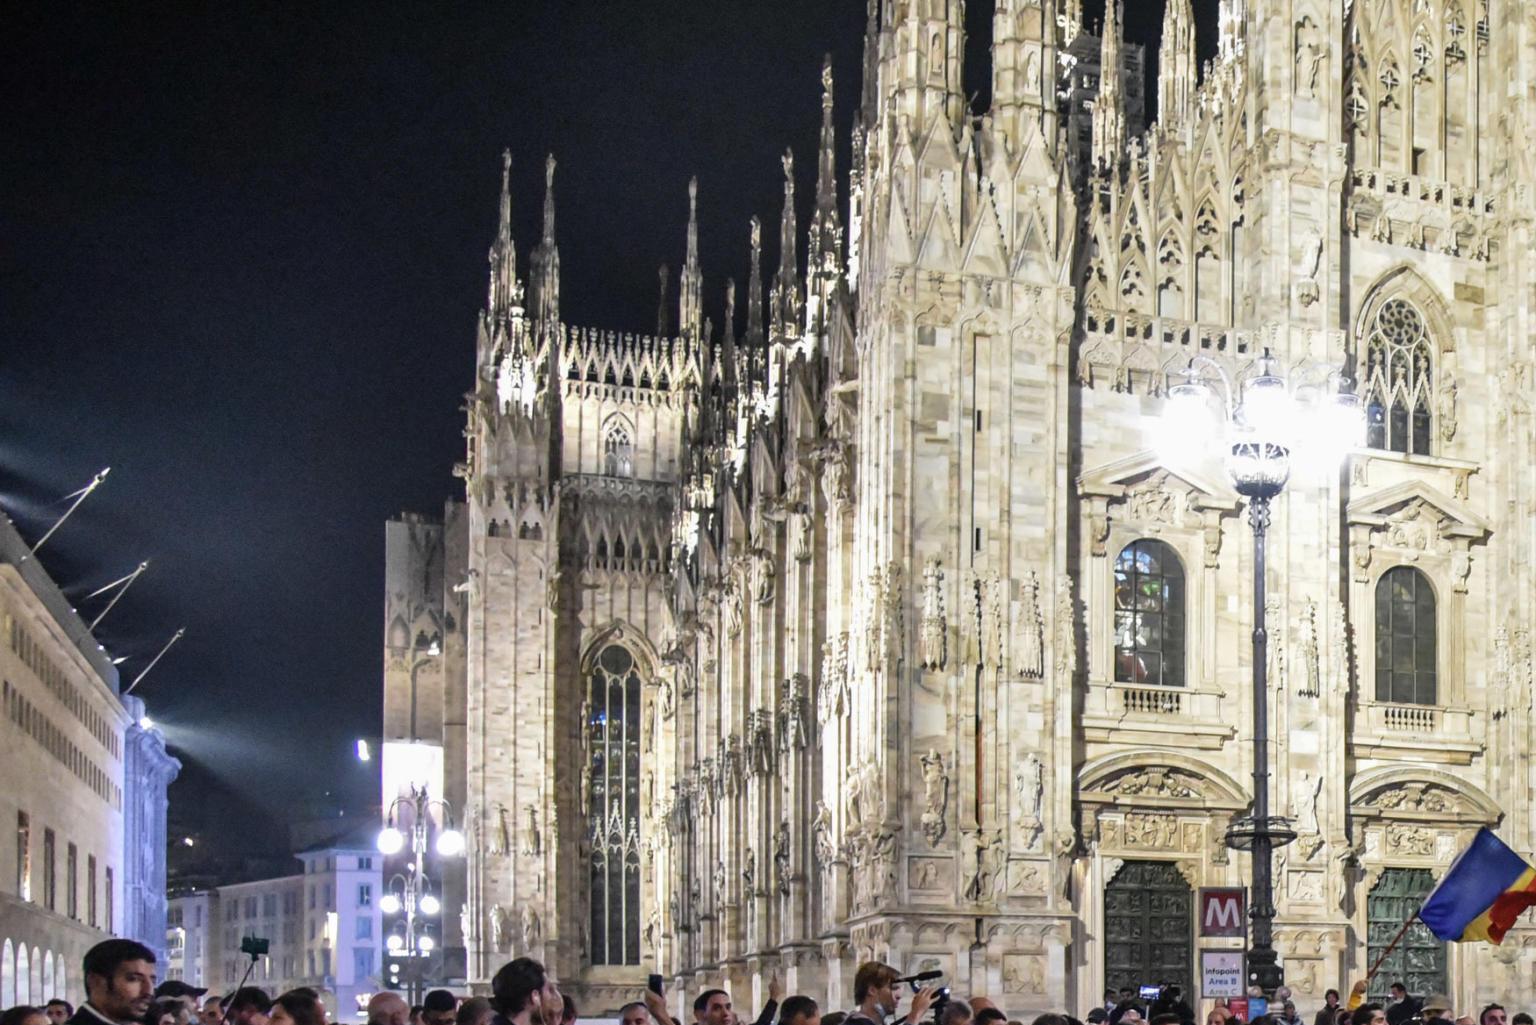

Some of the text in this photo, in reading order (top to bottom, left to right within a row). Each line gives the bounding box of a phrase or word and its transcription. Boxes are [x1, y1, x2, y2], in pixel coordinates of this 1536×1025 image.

[1205, 897, 1240, 928] M
[1205, 967, 1241, 977] infopoint
[1208, 977, 1238, 986] Area B
[1208, 988, 1238, 996] Area C
